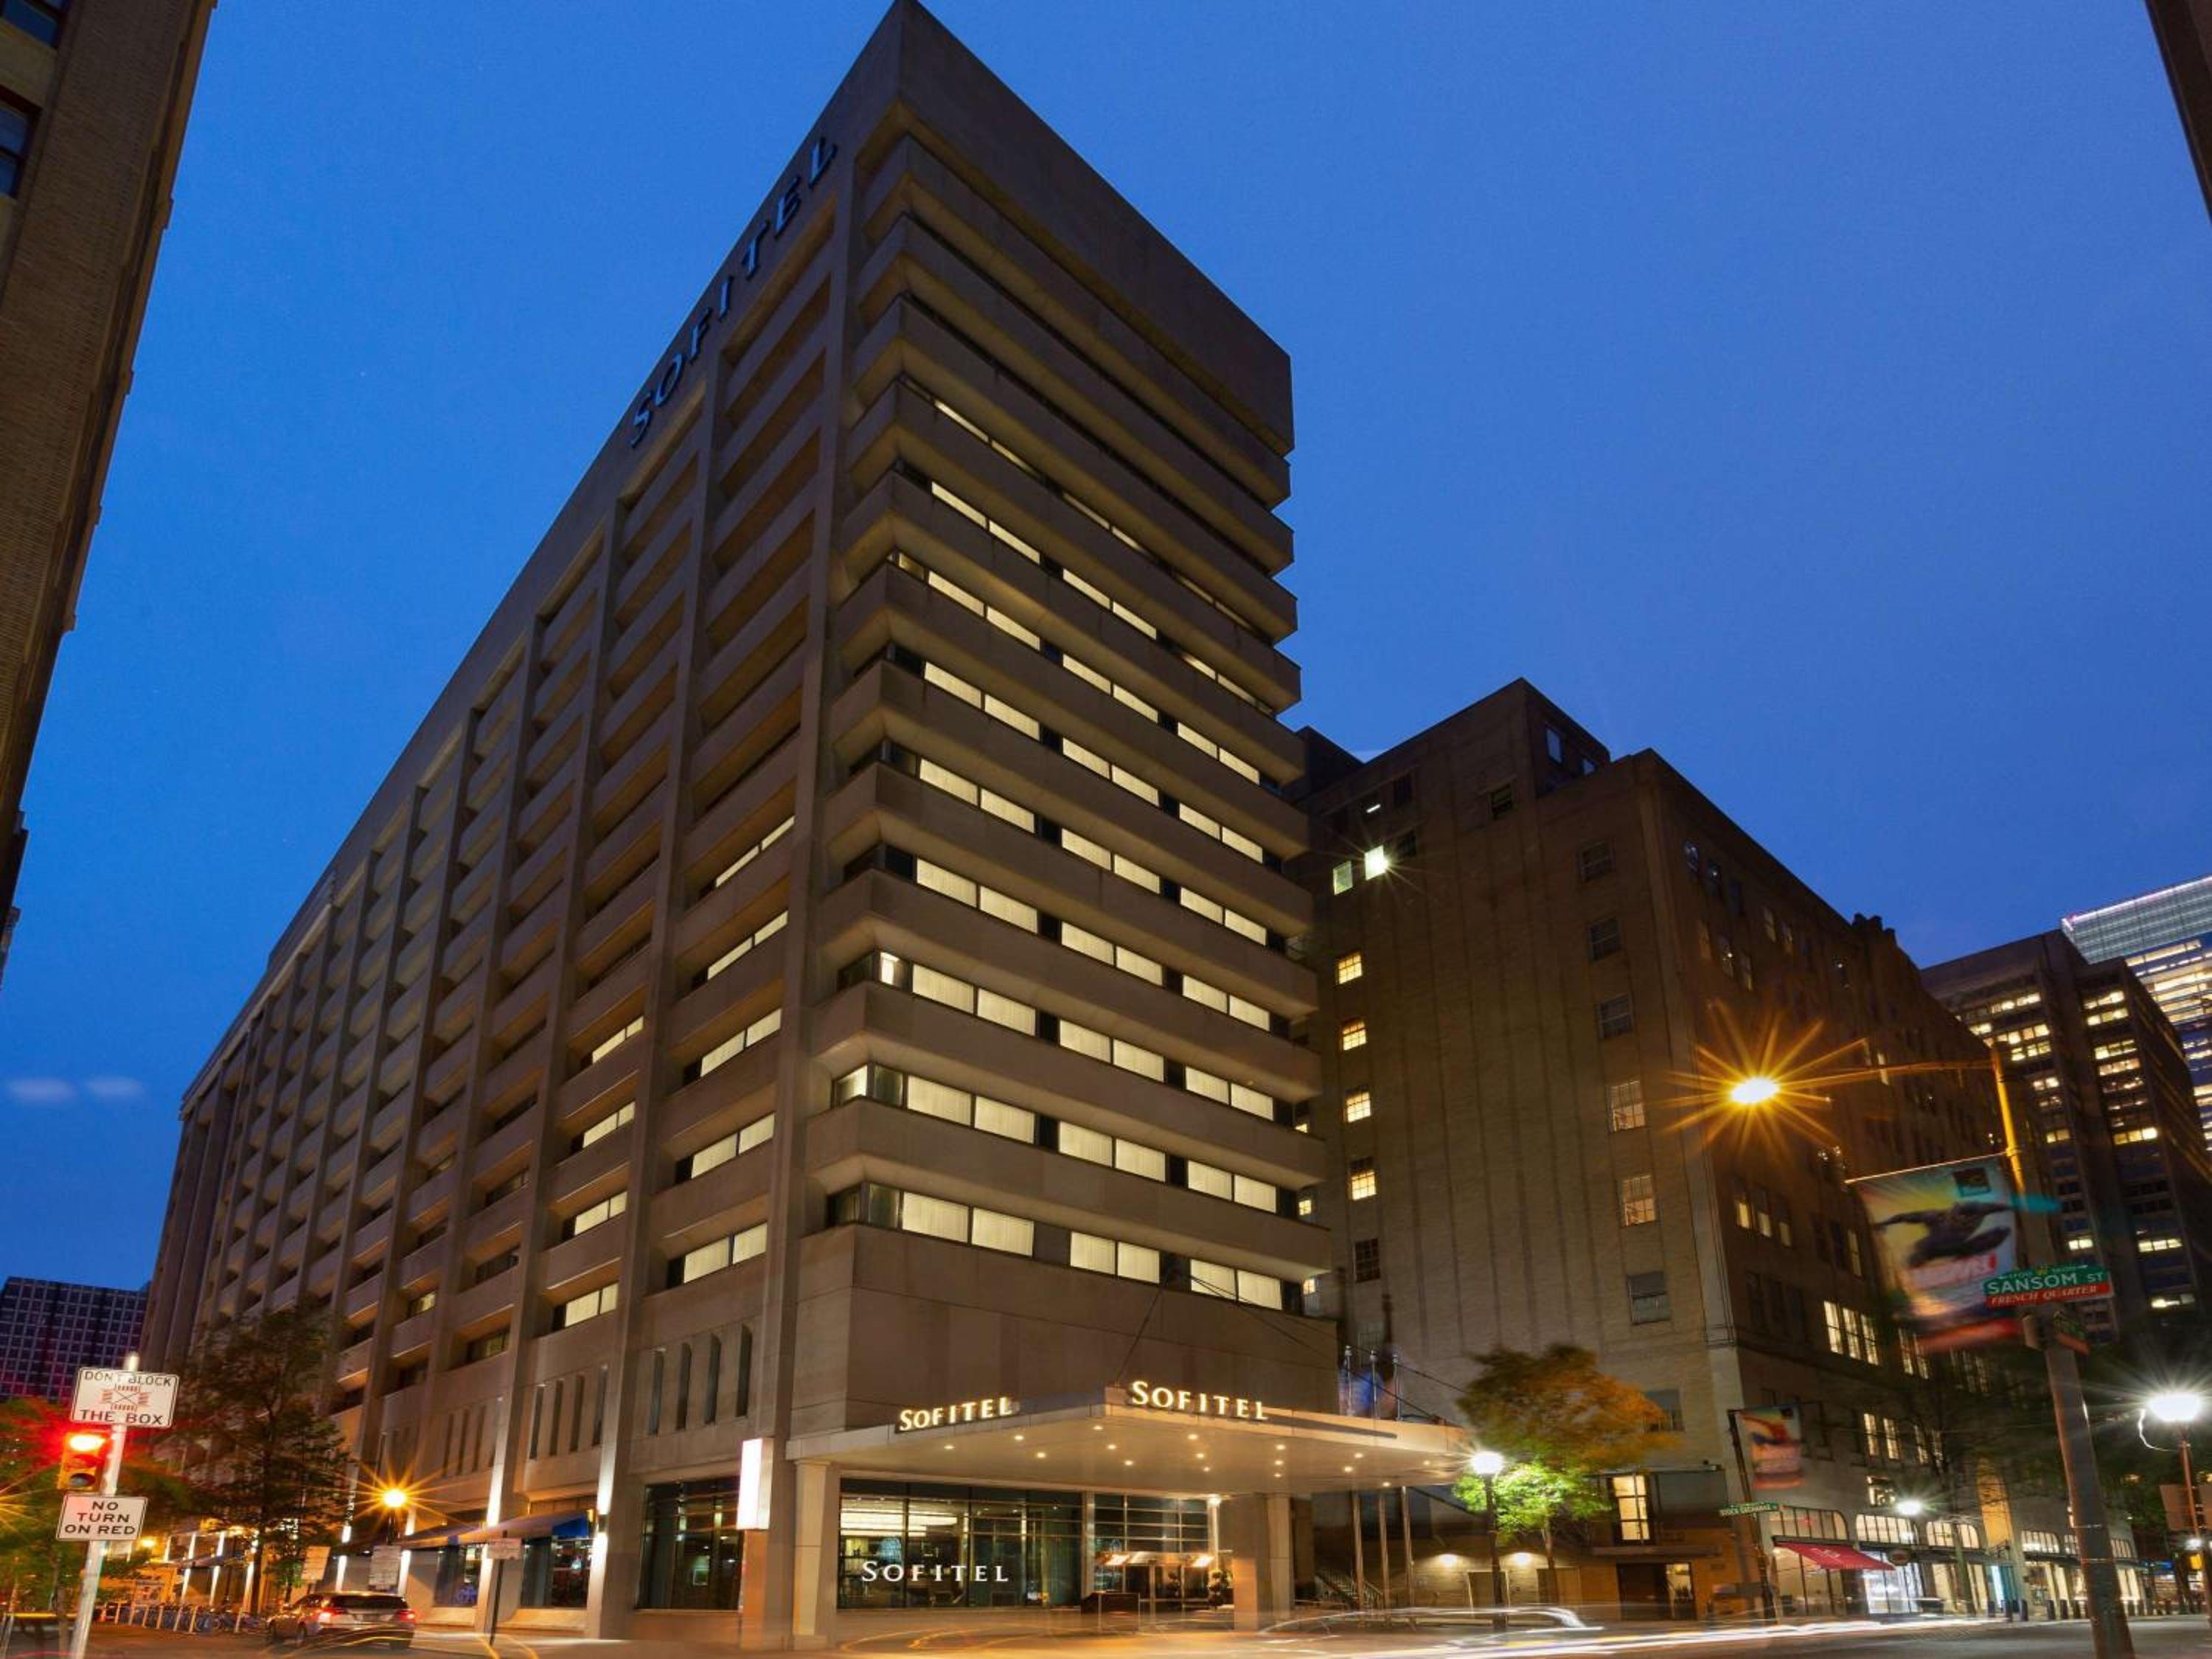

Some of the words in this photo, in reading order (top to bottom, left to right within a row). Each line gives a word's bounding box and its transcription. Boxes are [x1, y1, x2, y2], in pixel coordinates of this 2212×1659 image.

[632, 136, 838, 448] SOFITEL
[1987, 1273, 2078, 1295] SANSOM
[2087, 1273, 2103, 1283] ST
[1992, 1292, 2039, 1305] FRENCH
[2042, 1285, 2097, 1300] QUARTER
[84, 1371, 124, 1383] DONT
[128, 1374, 172, 1387] BLOCK
[1132, 1380, 1268, 1420] SOFITEL
[80, 1409, 116, 1422] THE
[125, 1412, 163, 1425] BOX
[899, 1397, 1012, 1432] SOFITEL
[92, 1500, 119, 1511] NO
[77, 1512, 130, 1523] TURN
[64, 1524, 91, 1534] ON
[97, 1526, 136, 1534] RED
[861, 1560, 1009, 1582] SOFITEL
